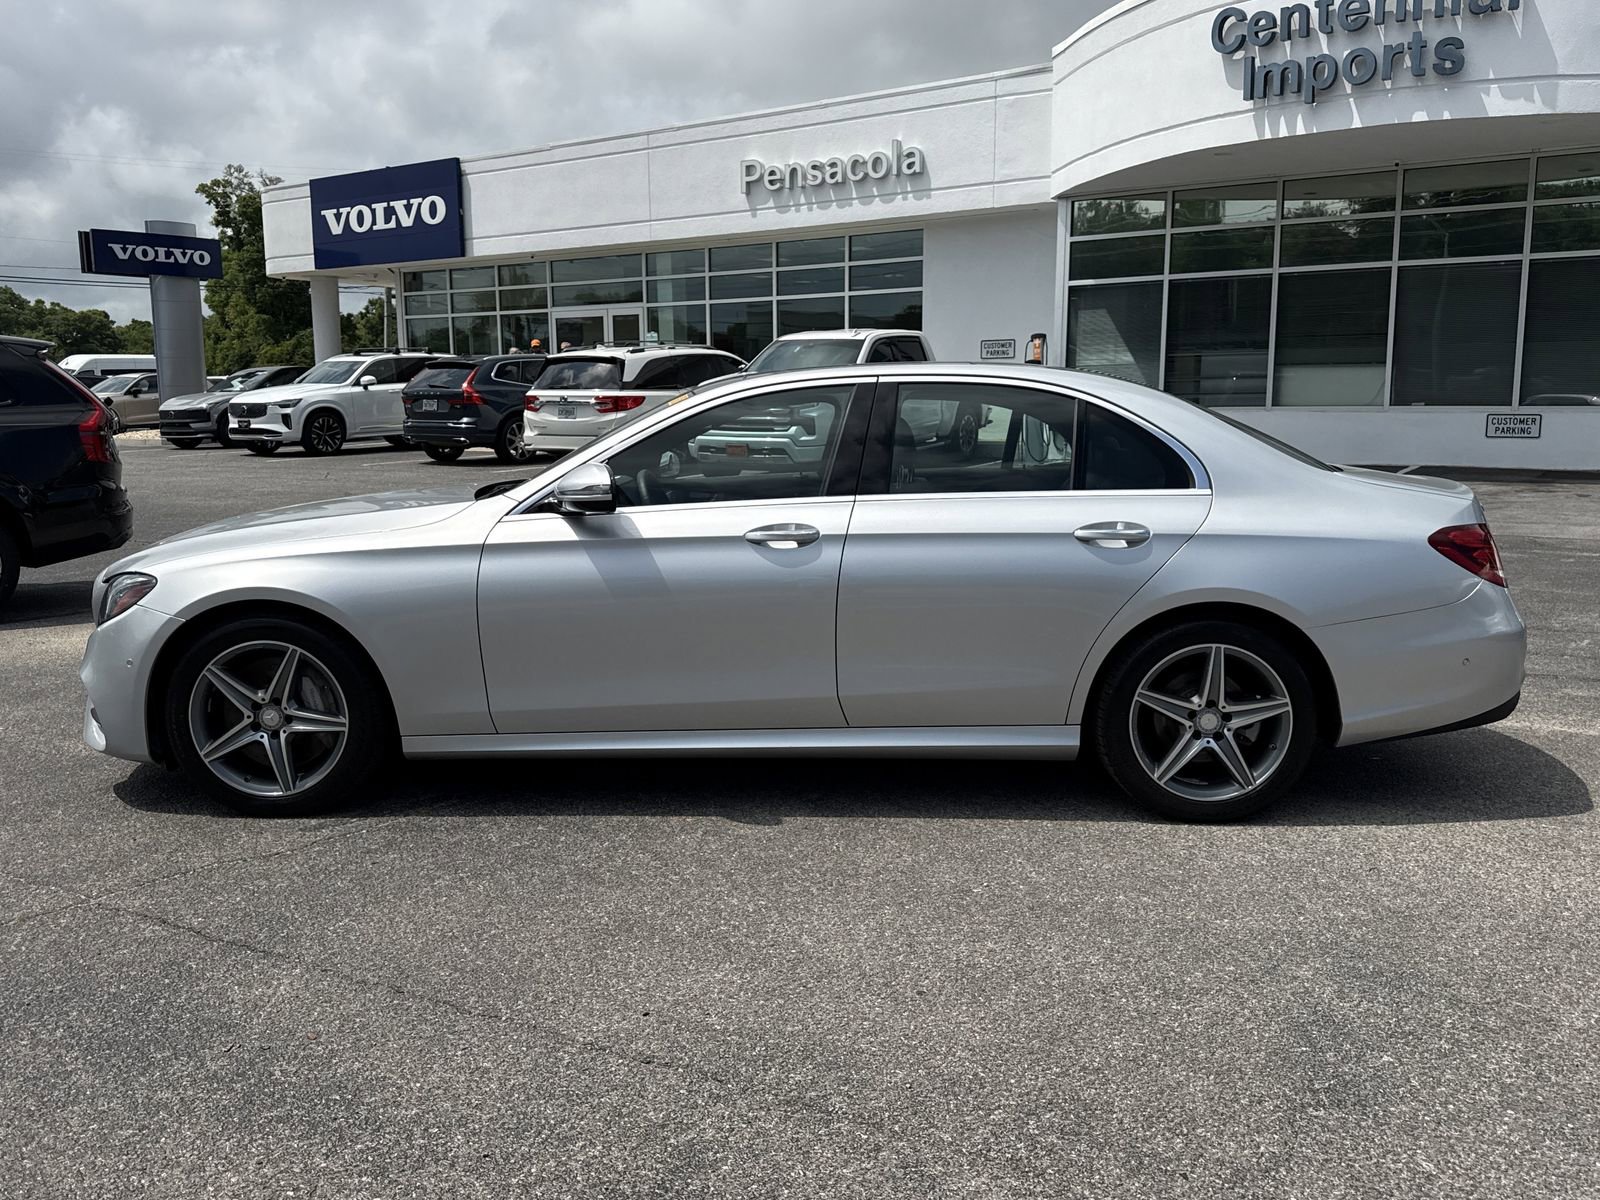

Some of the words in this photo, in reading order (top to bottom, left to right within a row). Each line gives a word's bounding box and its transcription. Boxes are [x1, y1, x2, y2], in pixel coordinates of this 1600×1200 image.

[1243, 31, 1465, 104] Imports
[740, 139, 924, 194] Pensacola
[321, 195, 447, 235] VOLVO
[107, 243, 211, 266] VOLVO
[1491, 417, 1537, 426] CUSTOMER
[1494, 426, 1532, 435] PARKING
